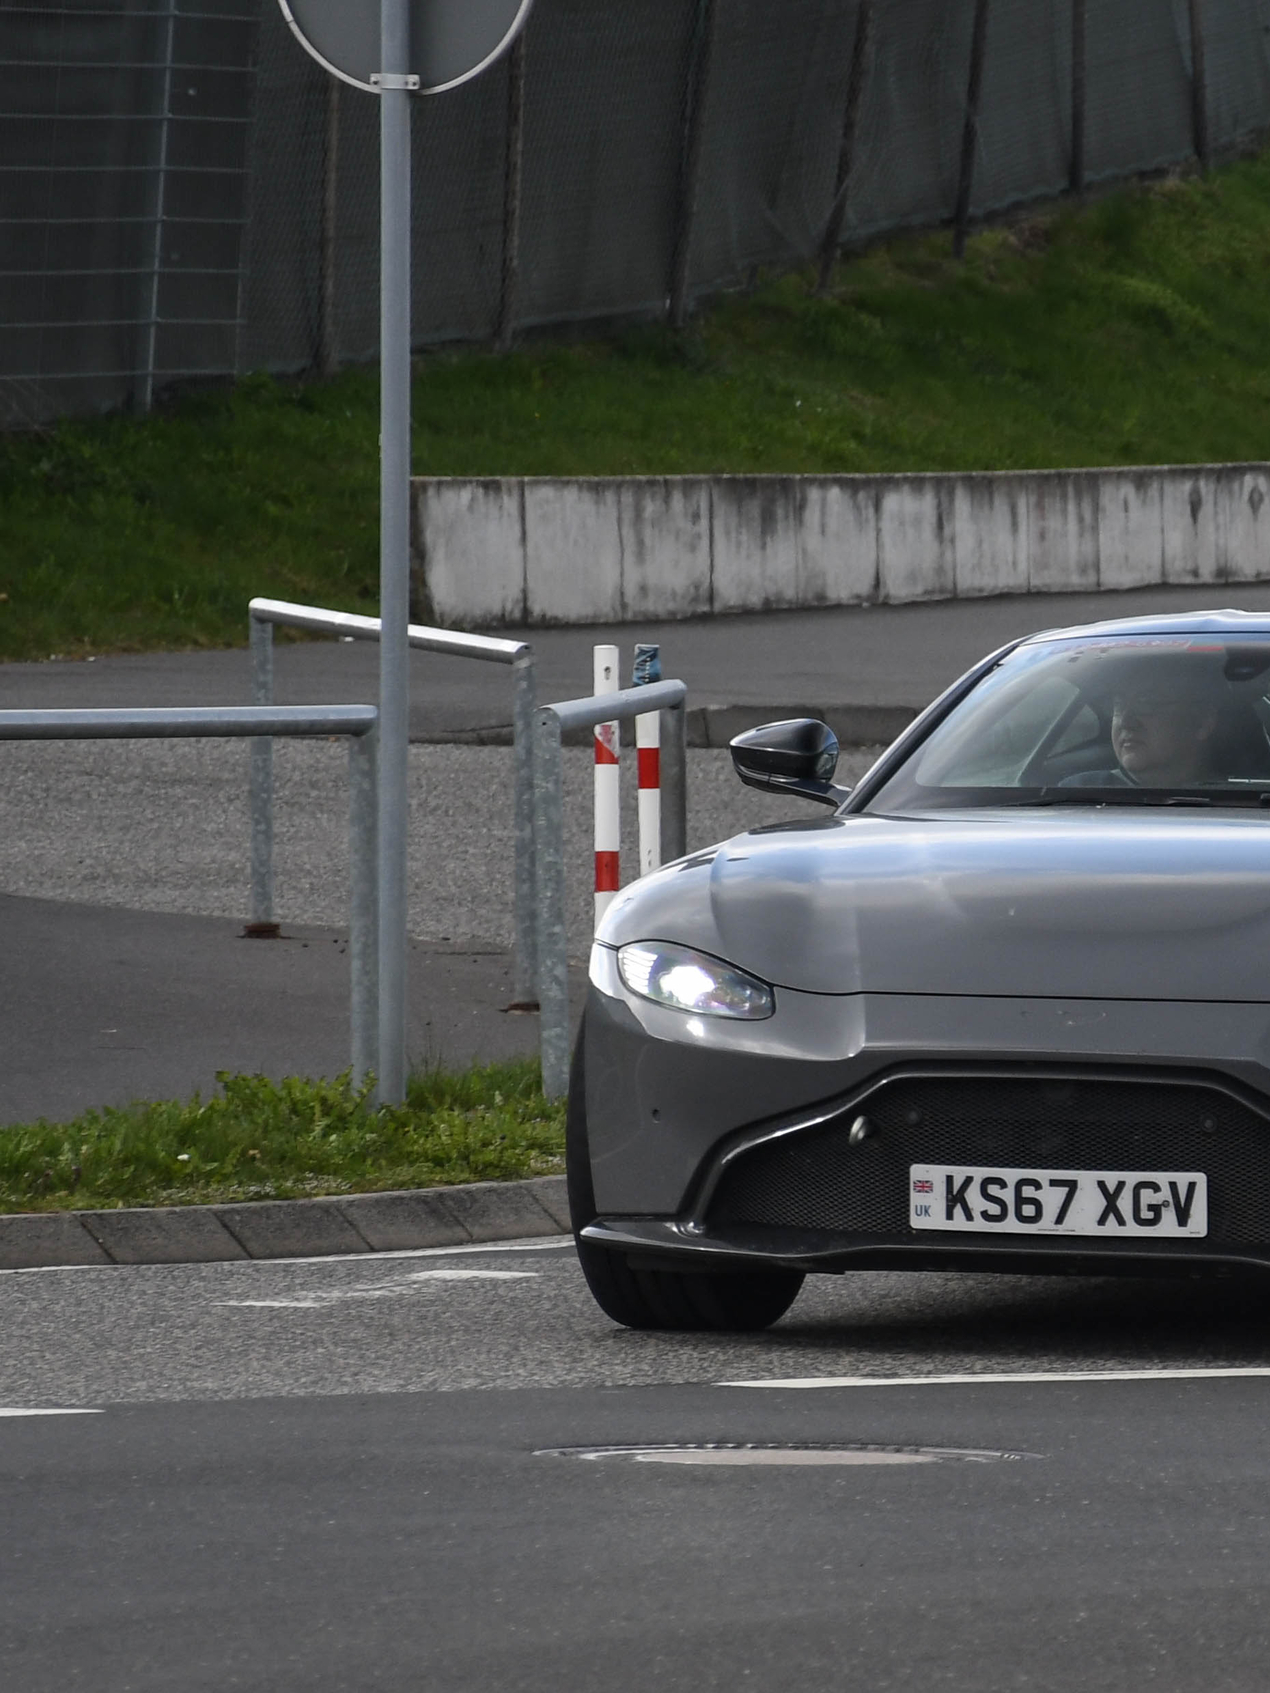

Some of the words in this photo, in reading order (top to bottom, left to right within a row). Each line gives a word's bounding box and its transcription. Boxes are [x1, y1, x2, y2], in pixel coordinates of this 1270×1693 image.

[914, 1204, 932, 1218] UK
[944, 1174, 1079, 1227] KS67
[1096, 1179, 1198, 1228] XGV
